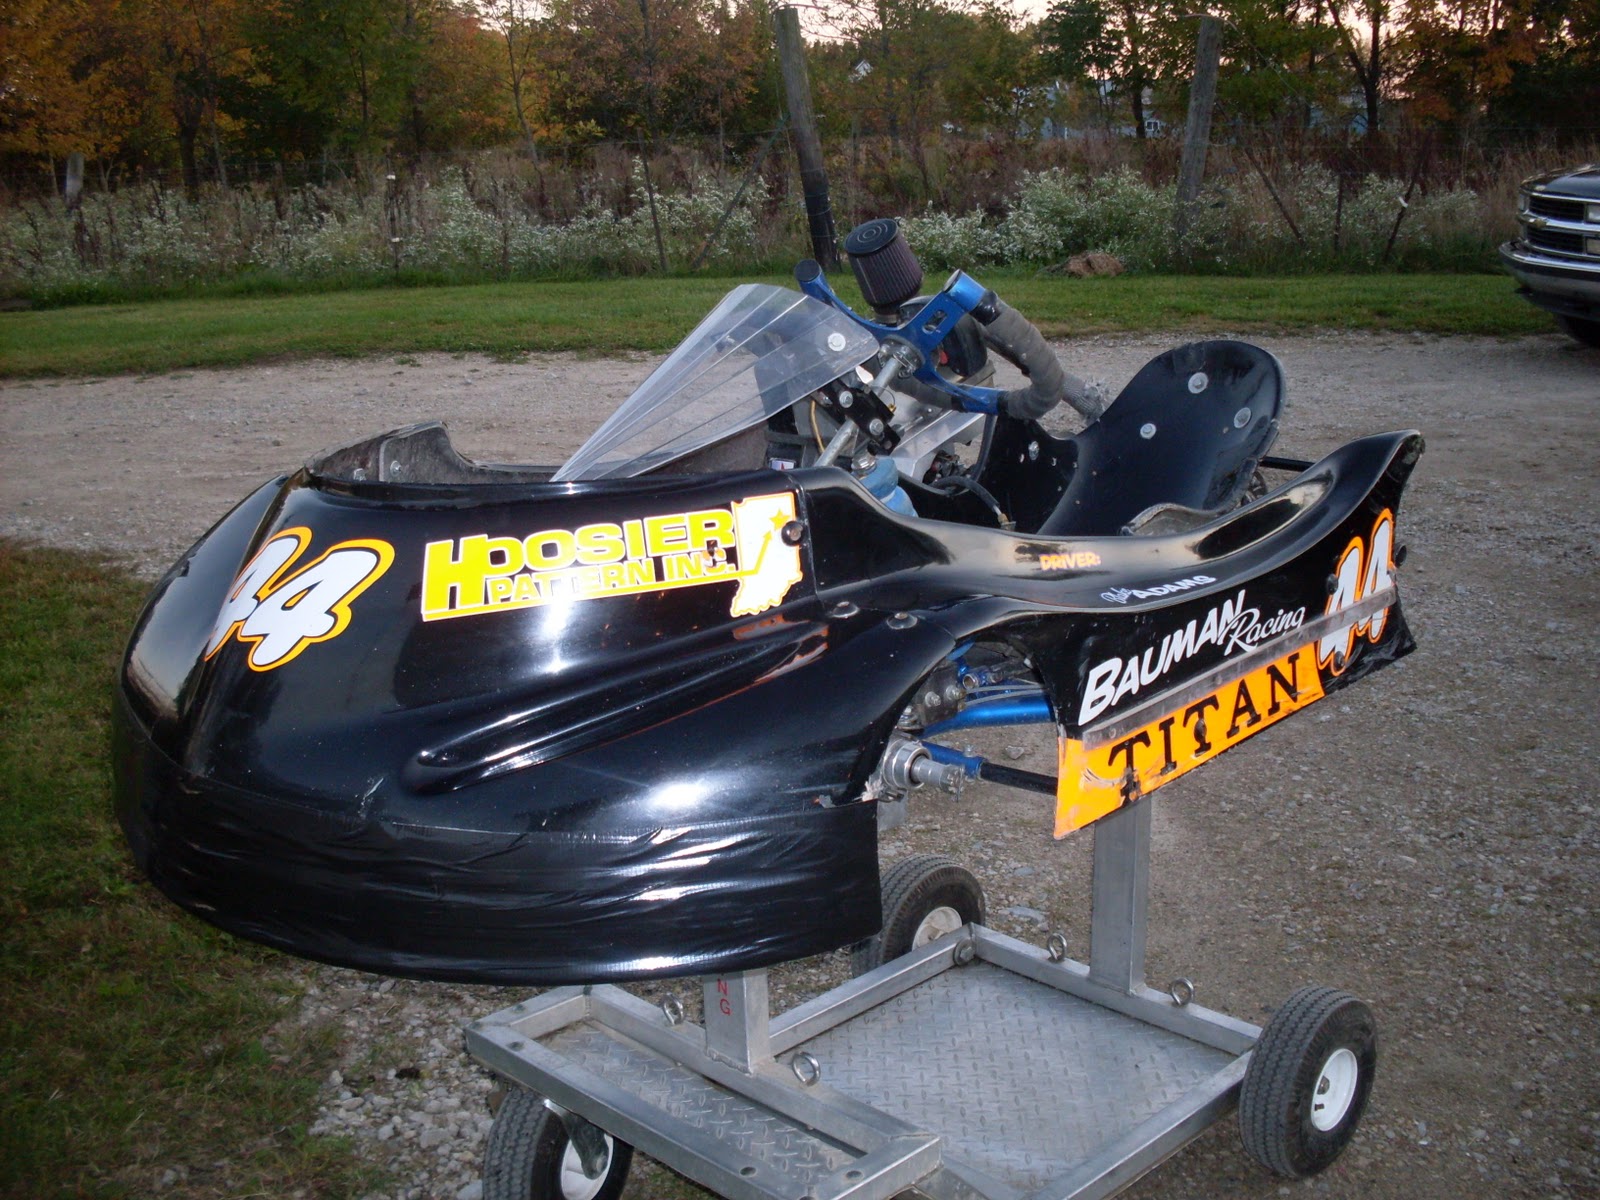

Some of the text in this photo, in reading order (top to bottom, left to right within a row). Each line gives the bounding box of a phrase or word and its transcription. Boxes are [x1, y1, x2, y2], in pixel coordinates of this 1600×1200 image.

[204, 526, 395, 672] 44
[422, 508, 736, 613] HOOSIER
[486, 545, 736, 604] PATTERN INC.
[1039, 551, 1101, 571] DRIVER:
[1131, 575, 1217, 599] ADAMS
[1317, 508, 1396, 677] 44
[1078, 590, 1305, 726] BAUMAN Racing
[1108, 653, 1301, 801] TITAN
